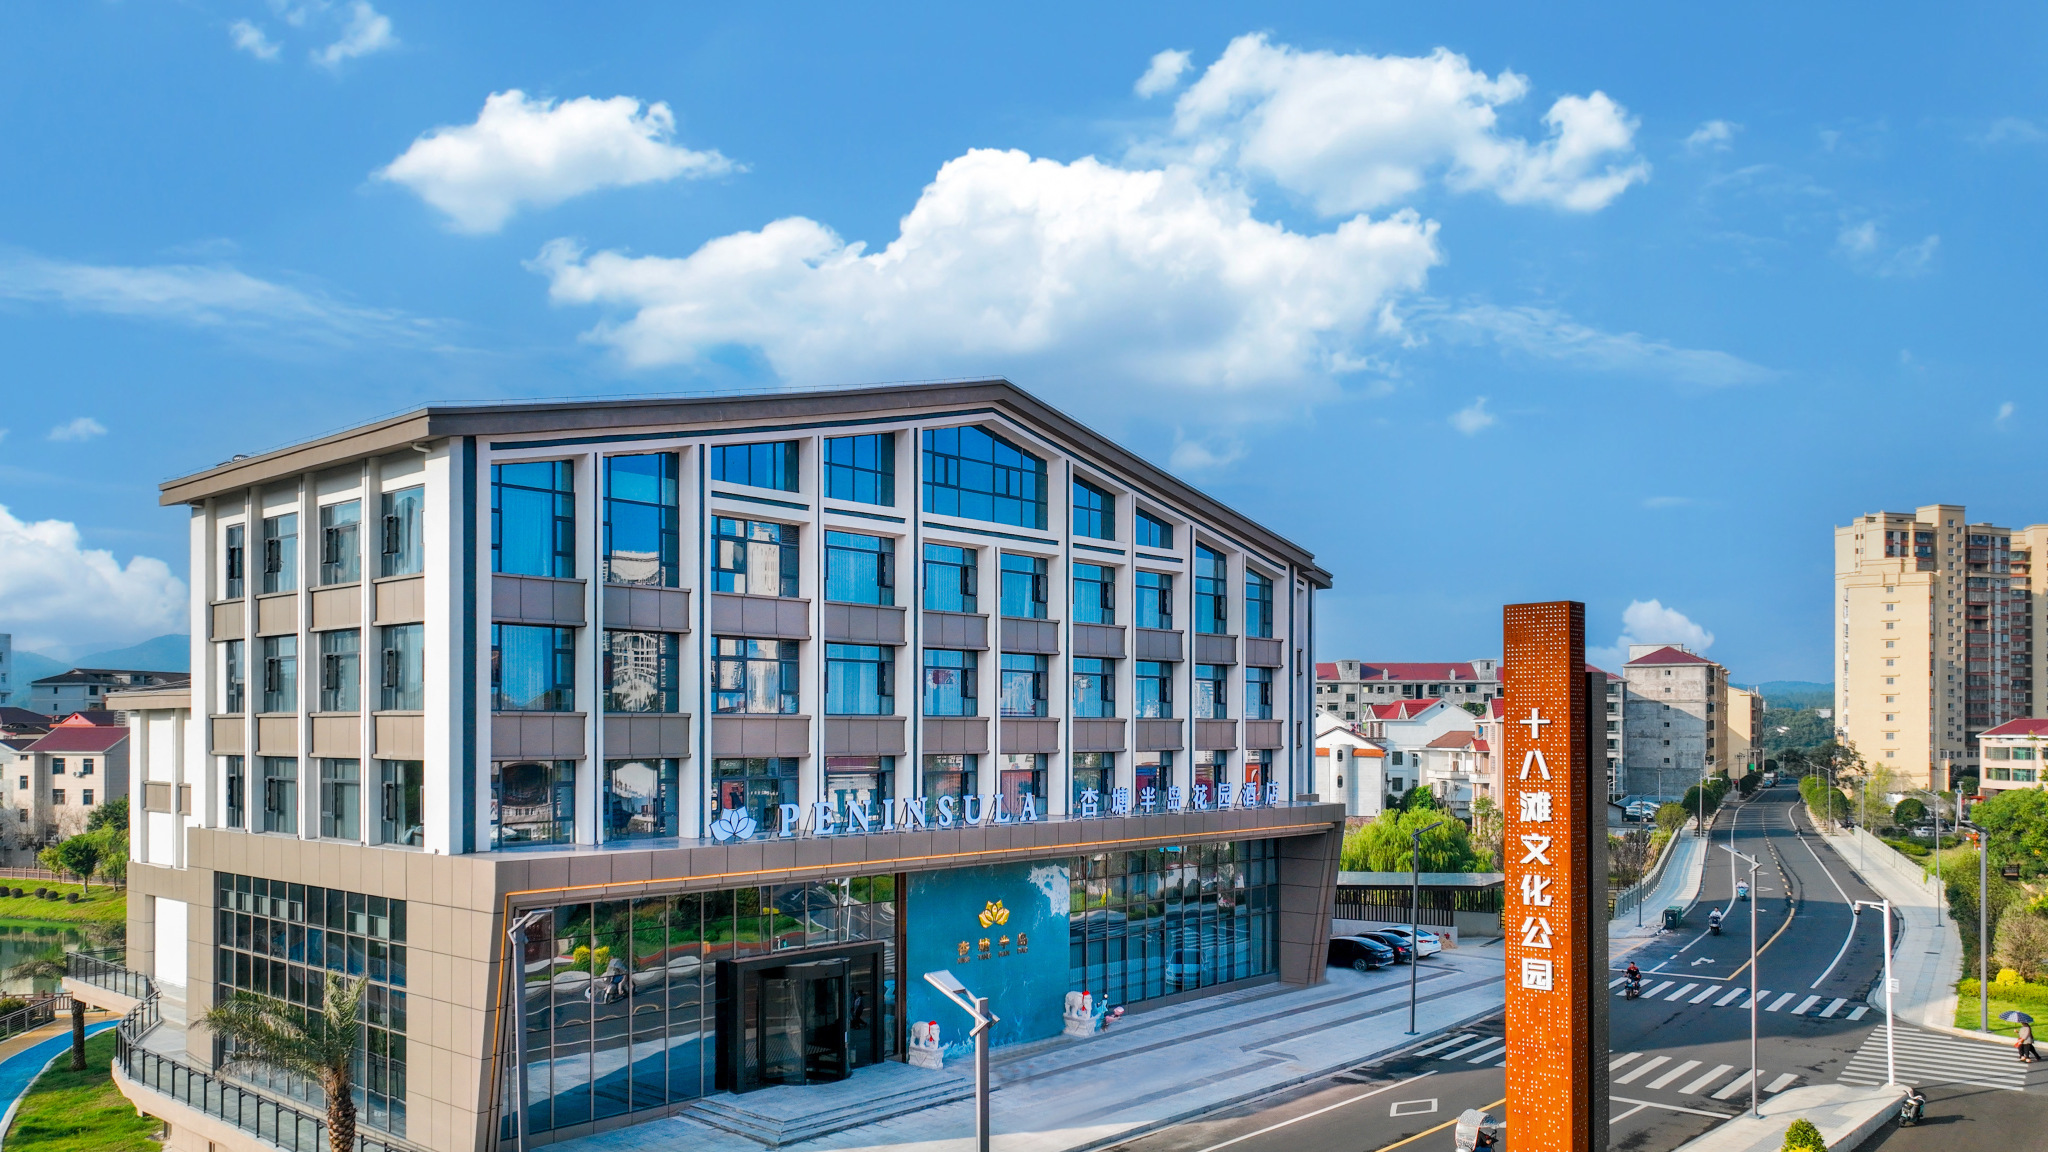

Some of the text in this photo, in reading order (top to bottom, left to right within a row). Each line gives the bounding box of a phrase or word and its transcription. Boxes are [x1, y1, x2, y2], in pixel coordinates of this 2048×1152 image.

[778, 792, 1038, 838] PENINSULA
[1080, 781, 1280, 817] 杏塘半岛花园酒店
[1519, 707, 1554, 992] 十八滩文化公园
